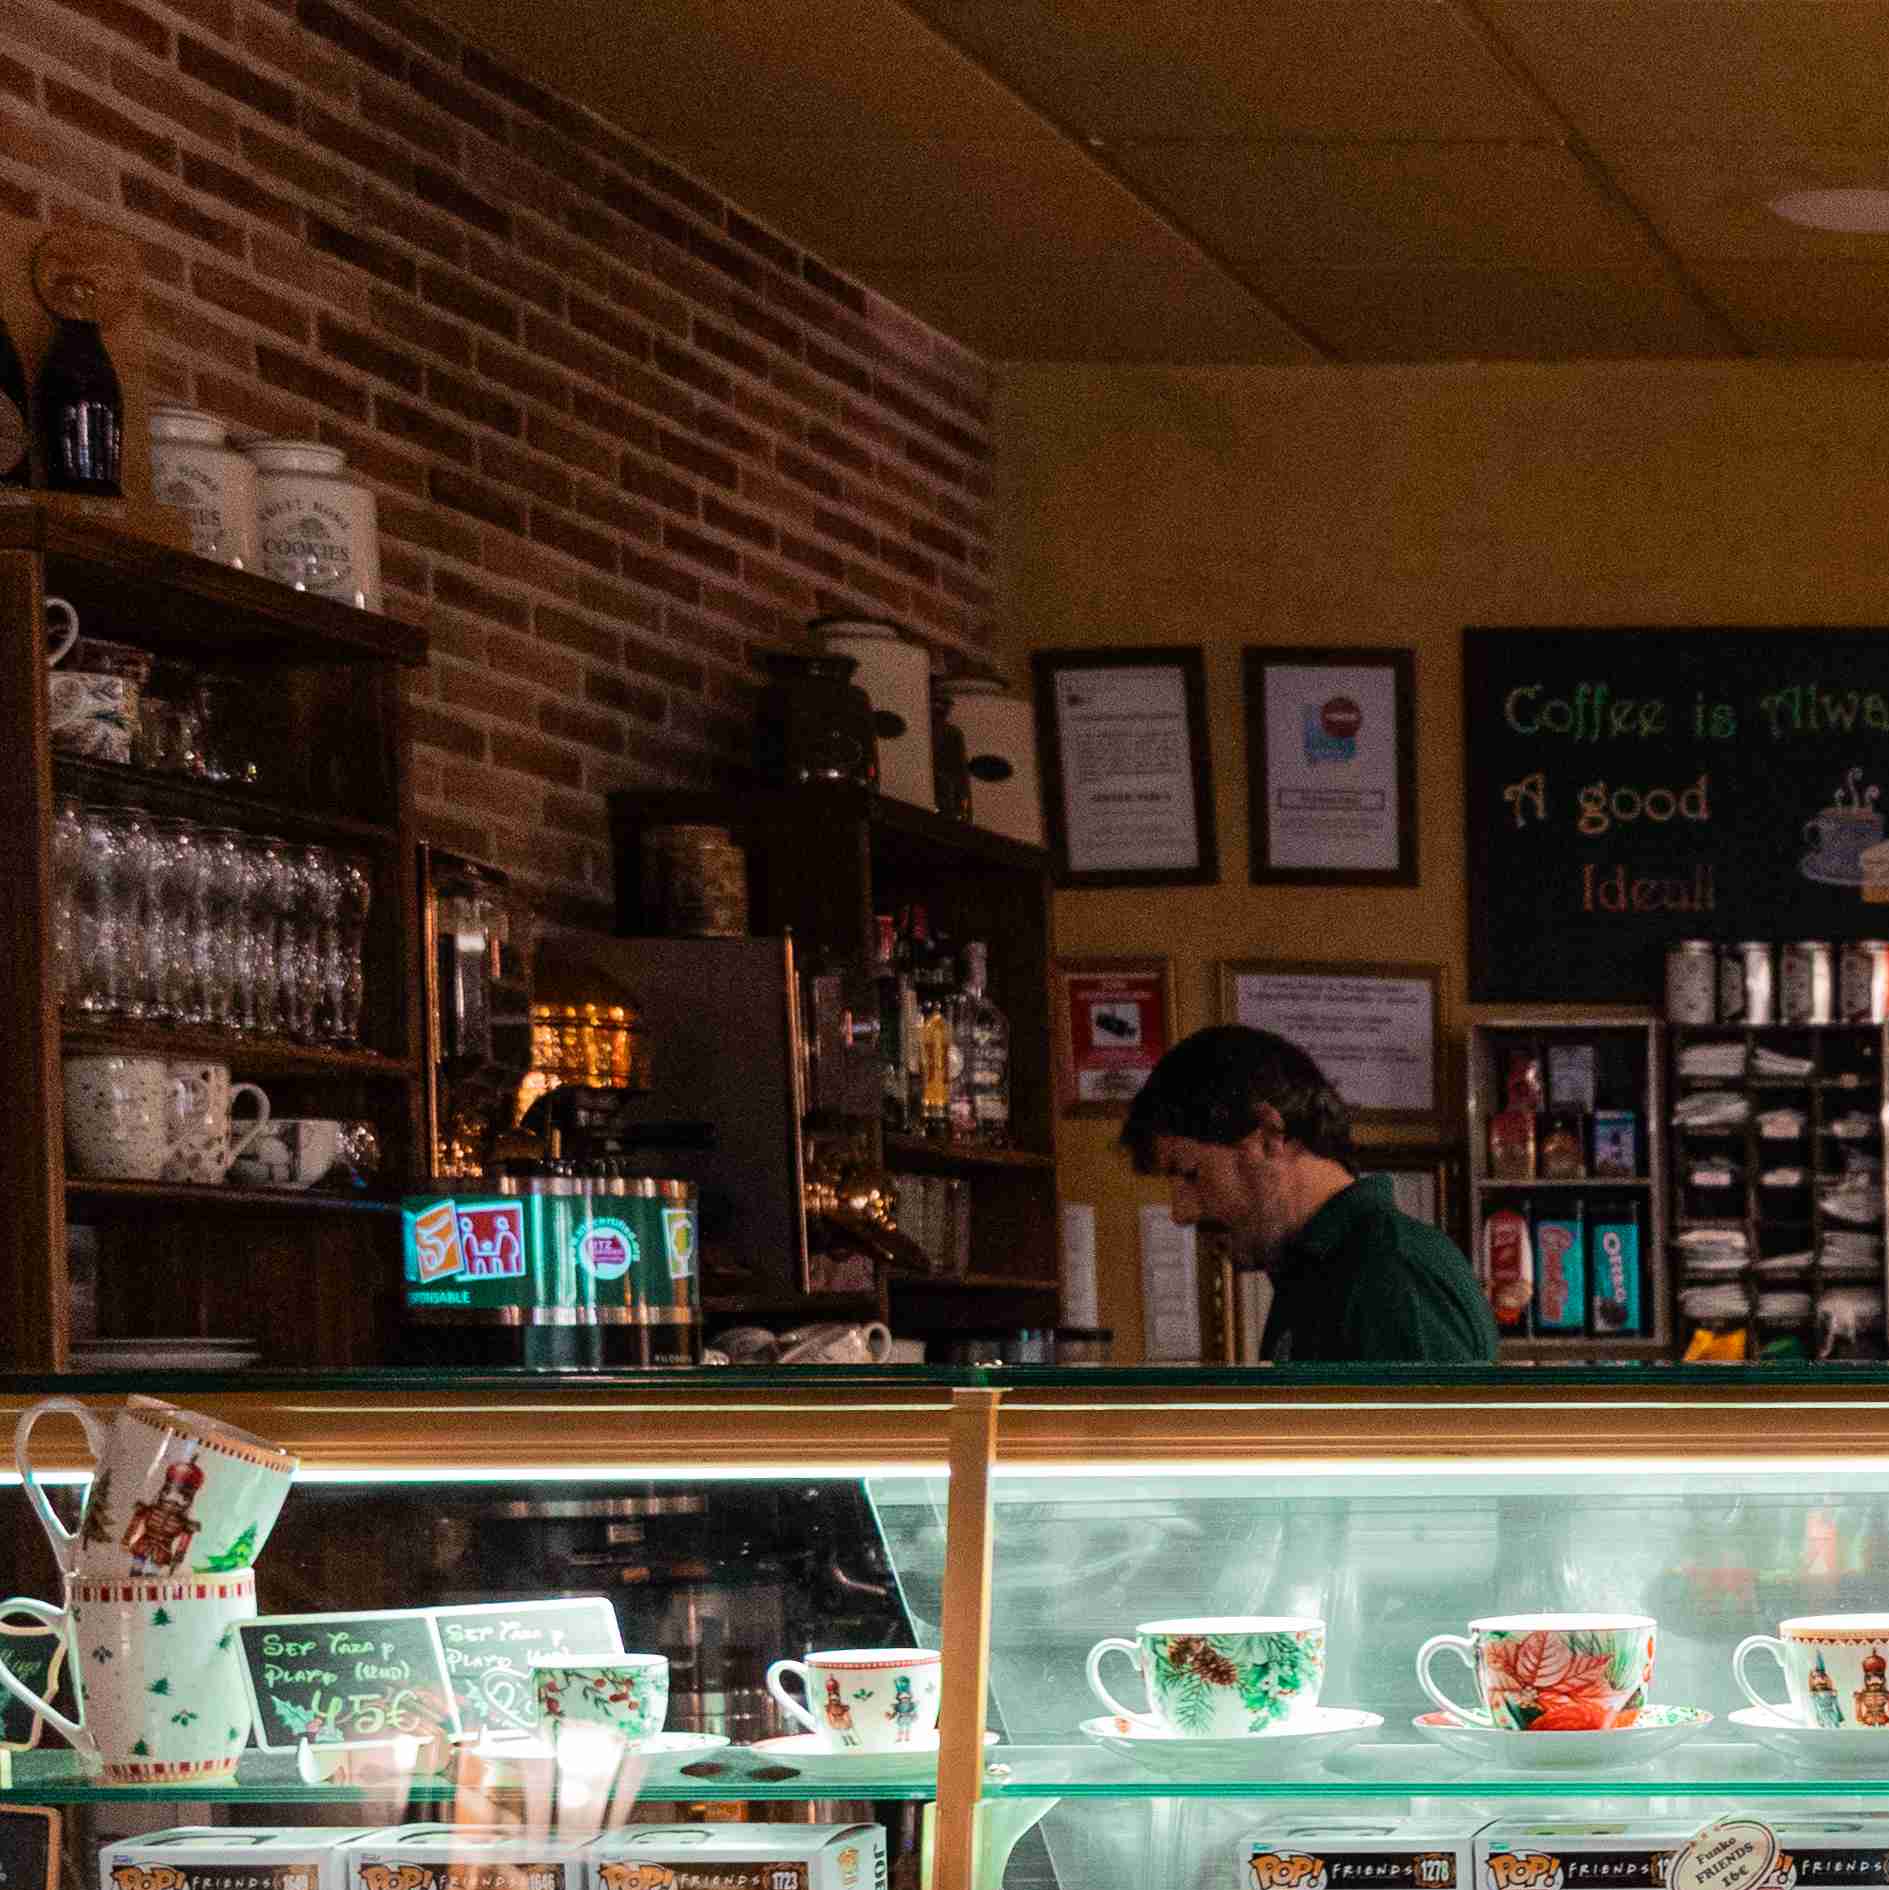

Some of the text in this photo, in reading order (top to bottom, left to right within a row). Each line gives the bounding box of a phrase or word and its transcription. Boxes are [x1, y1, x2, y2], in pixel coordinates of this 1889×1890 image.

[1503, 682, 1666, 742] Coffee
[1694, 691, 1738, 740] is
[1503, 772, 1712, 835] A good
[1695, 1836, 1737, 1866] Funko
[1695, 1842, 1755, 1886] FRIENDS
[1801, 1860, 1882, 1877] FRIENDS
[679, 1872, 761, 1890] FRIENDS
[771, 1871, 799, 1890] 1723
[1248, 1853, 1326, 1890] POP!
[1331, 1863, 1413, 1880] FRIENDS
[1485, 1852, 1561, 1890] POP!
[1567, 1862, 1650, 1879] FRIENDS
